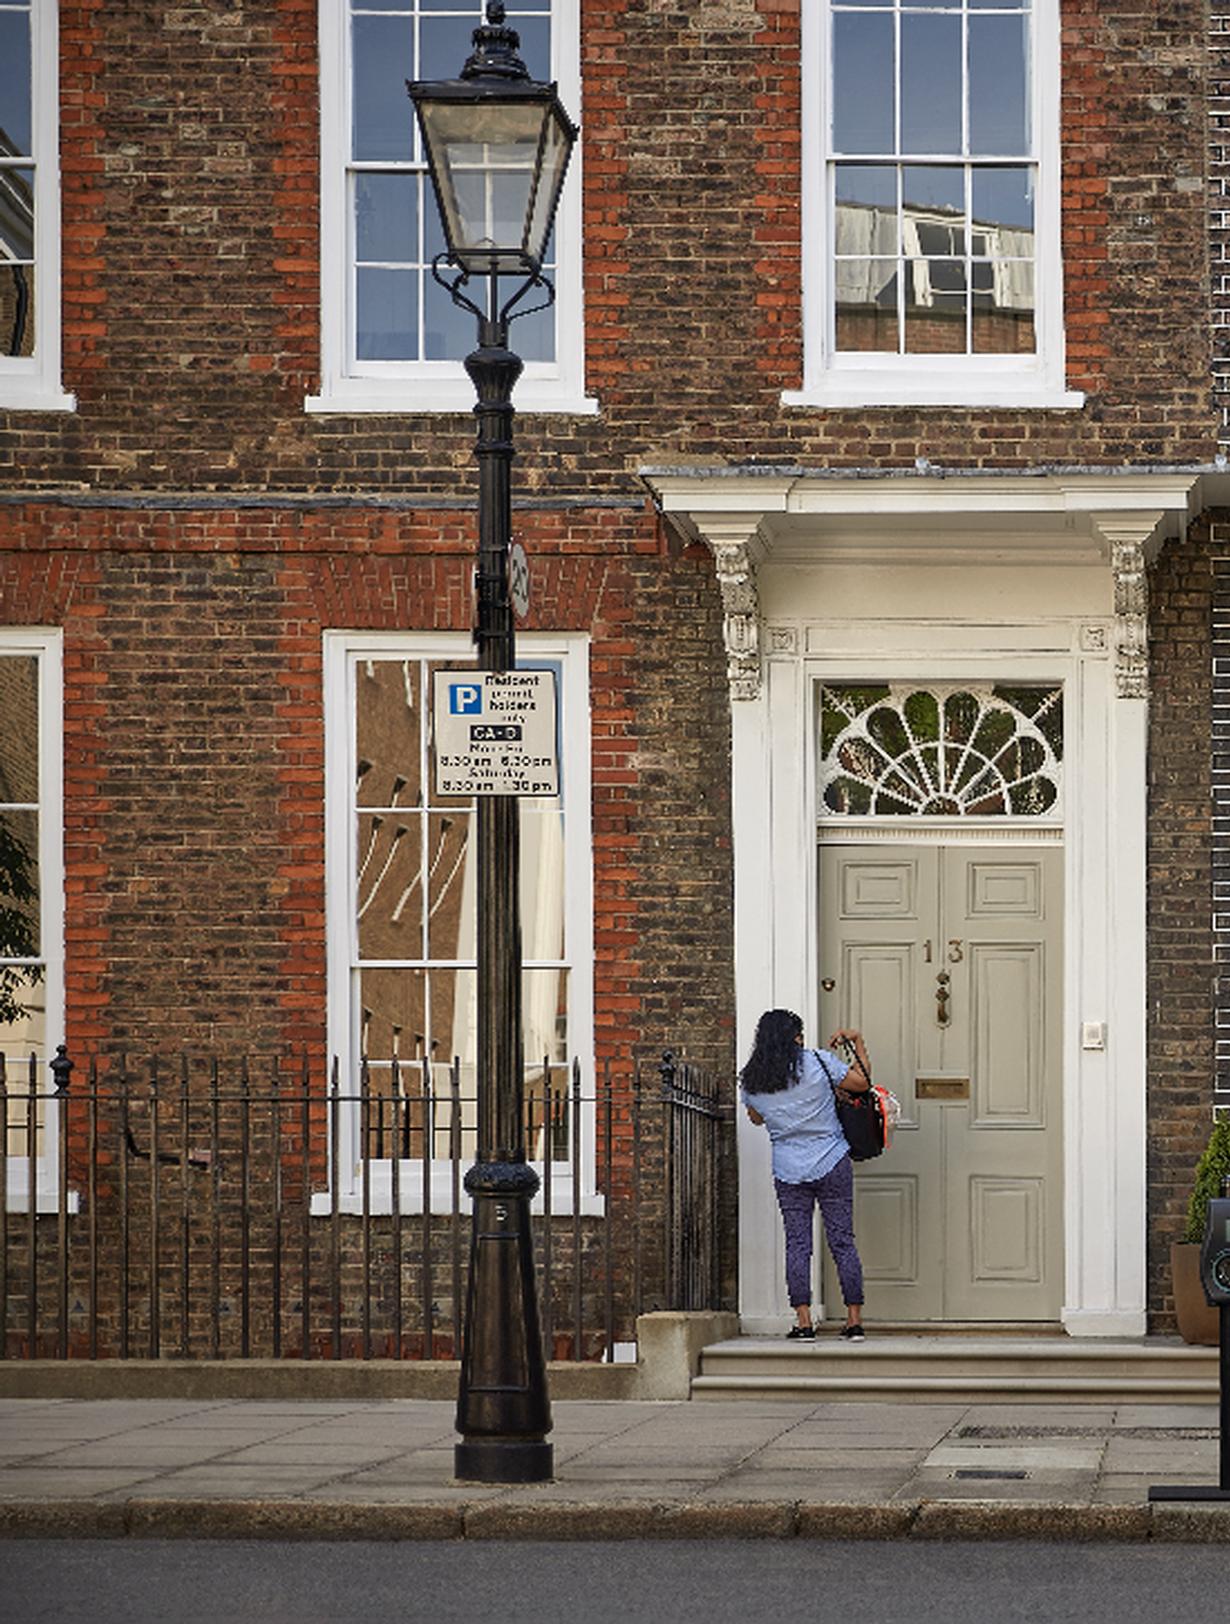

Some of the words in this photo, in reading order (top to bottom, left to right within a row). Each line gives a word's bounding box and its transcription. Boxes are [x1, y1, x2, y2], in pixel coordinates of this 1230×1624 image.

[485, 675, 540, 686] Resident
[456, 687, 478, 712] P
[489, 701, 536, 711] holders
[923, 939, 963, 963] 13
